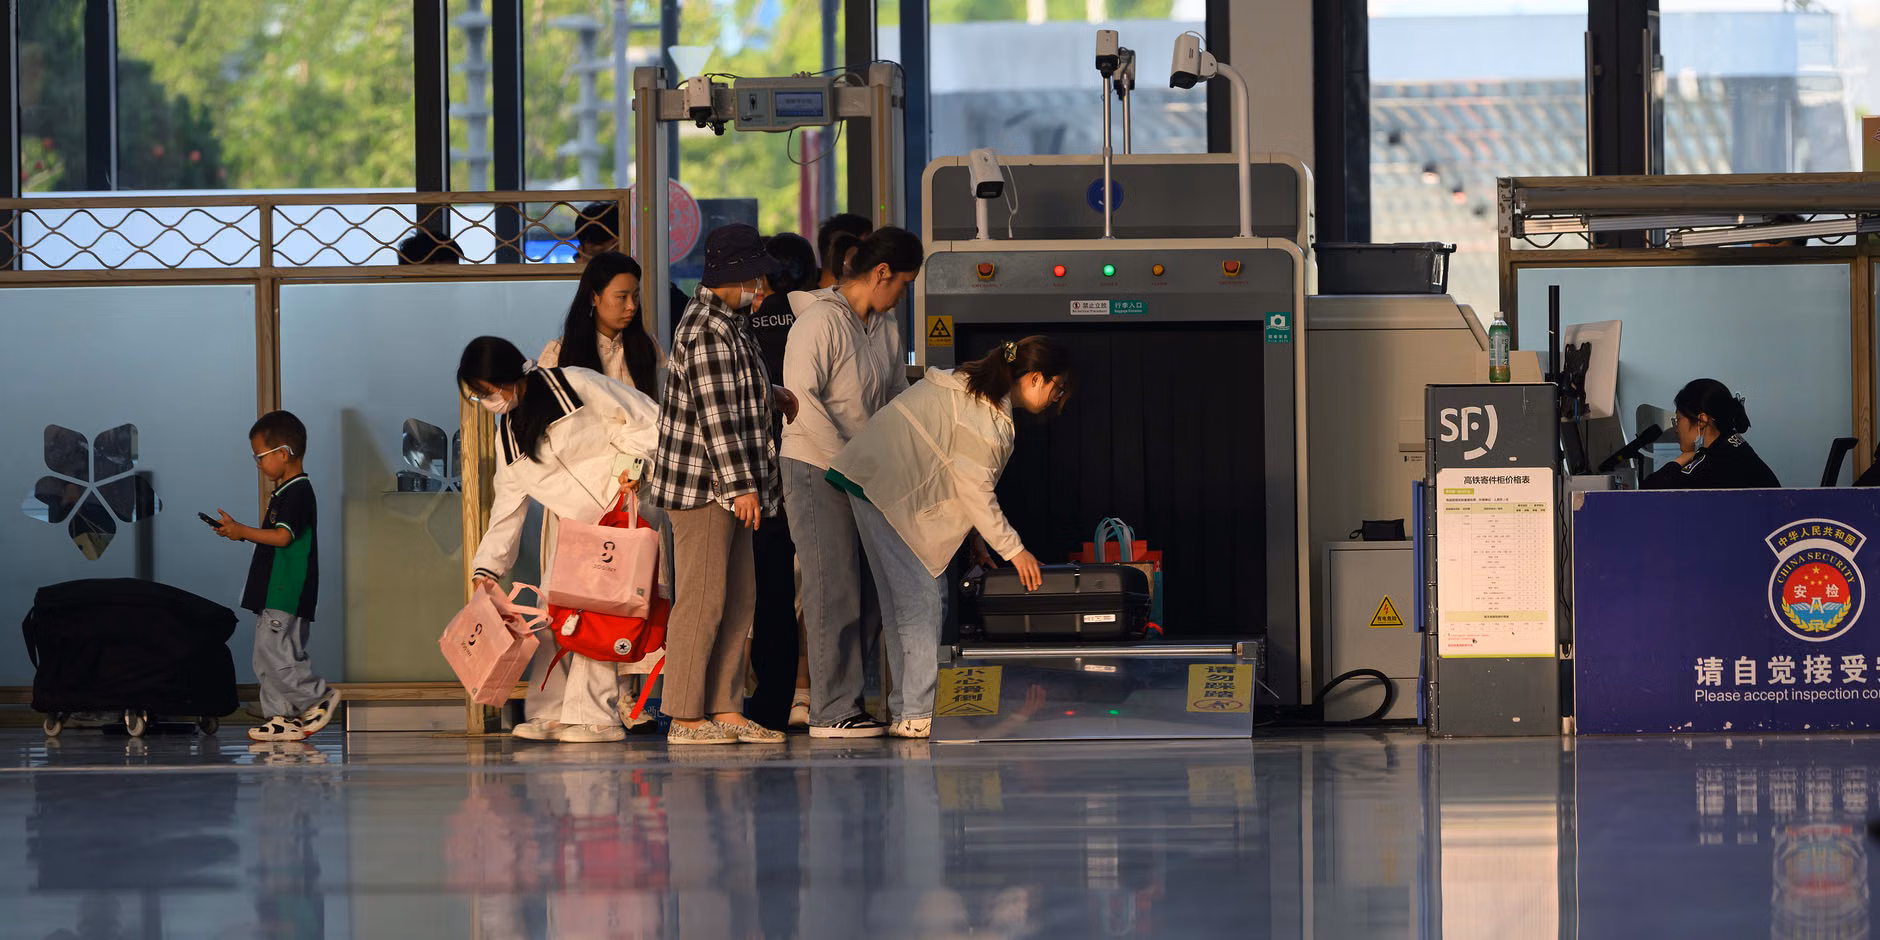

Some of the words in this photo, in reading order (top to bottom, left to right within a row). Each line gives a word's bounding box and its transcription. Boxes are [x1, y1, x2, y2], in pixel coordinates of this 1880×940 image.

[752, 314, 794, 328] SECUR
[1463, 475, 1531, 485] 高铁寄件柜价格表
[1778, 525, 1856, 547] 中华人民共和国
[1777, 555, 1805, 583] CHINA
[1807, 551, 1855, 583] SECURITY
[1204, 665, 1236, 698] 请勿踩踏
[1694, 654, 1880, 687] 请自觉接受
[952, 668, 985, 702] 小心滑倒
[1695, 689, 1741, 702] Please
[1744, 688, 1789, 703] accept
[1791, 687, 1859, 703] inspection
